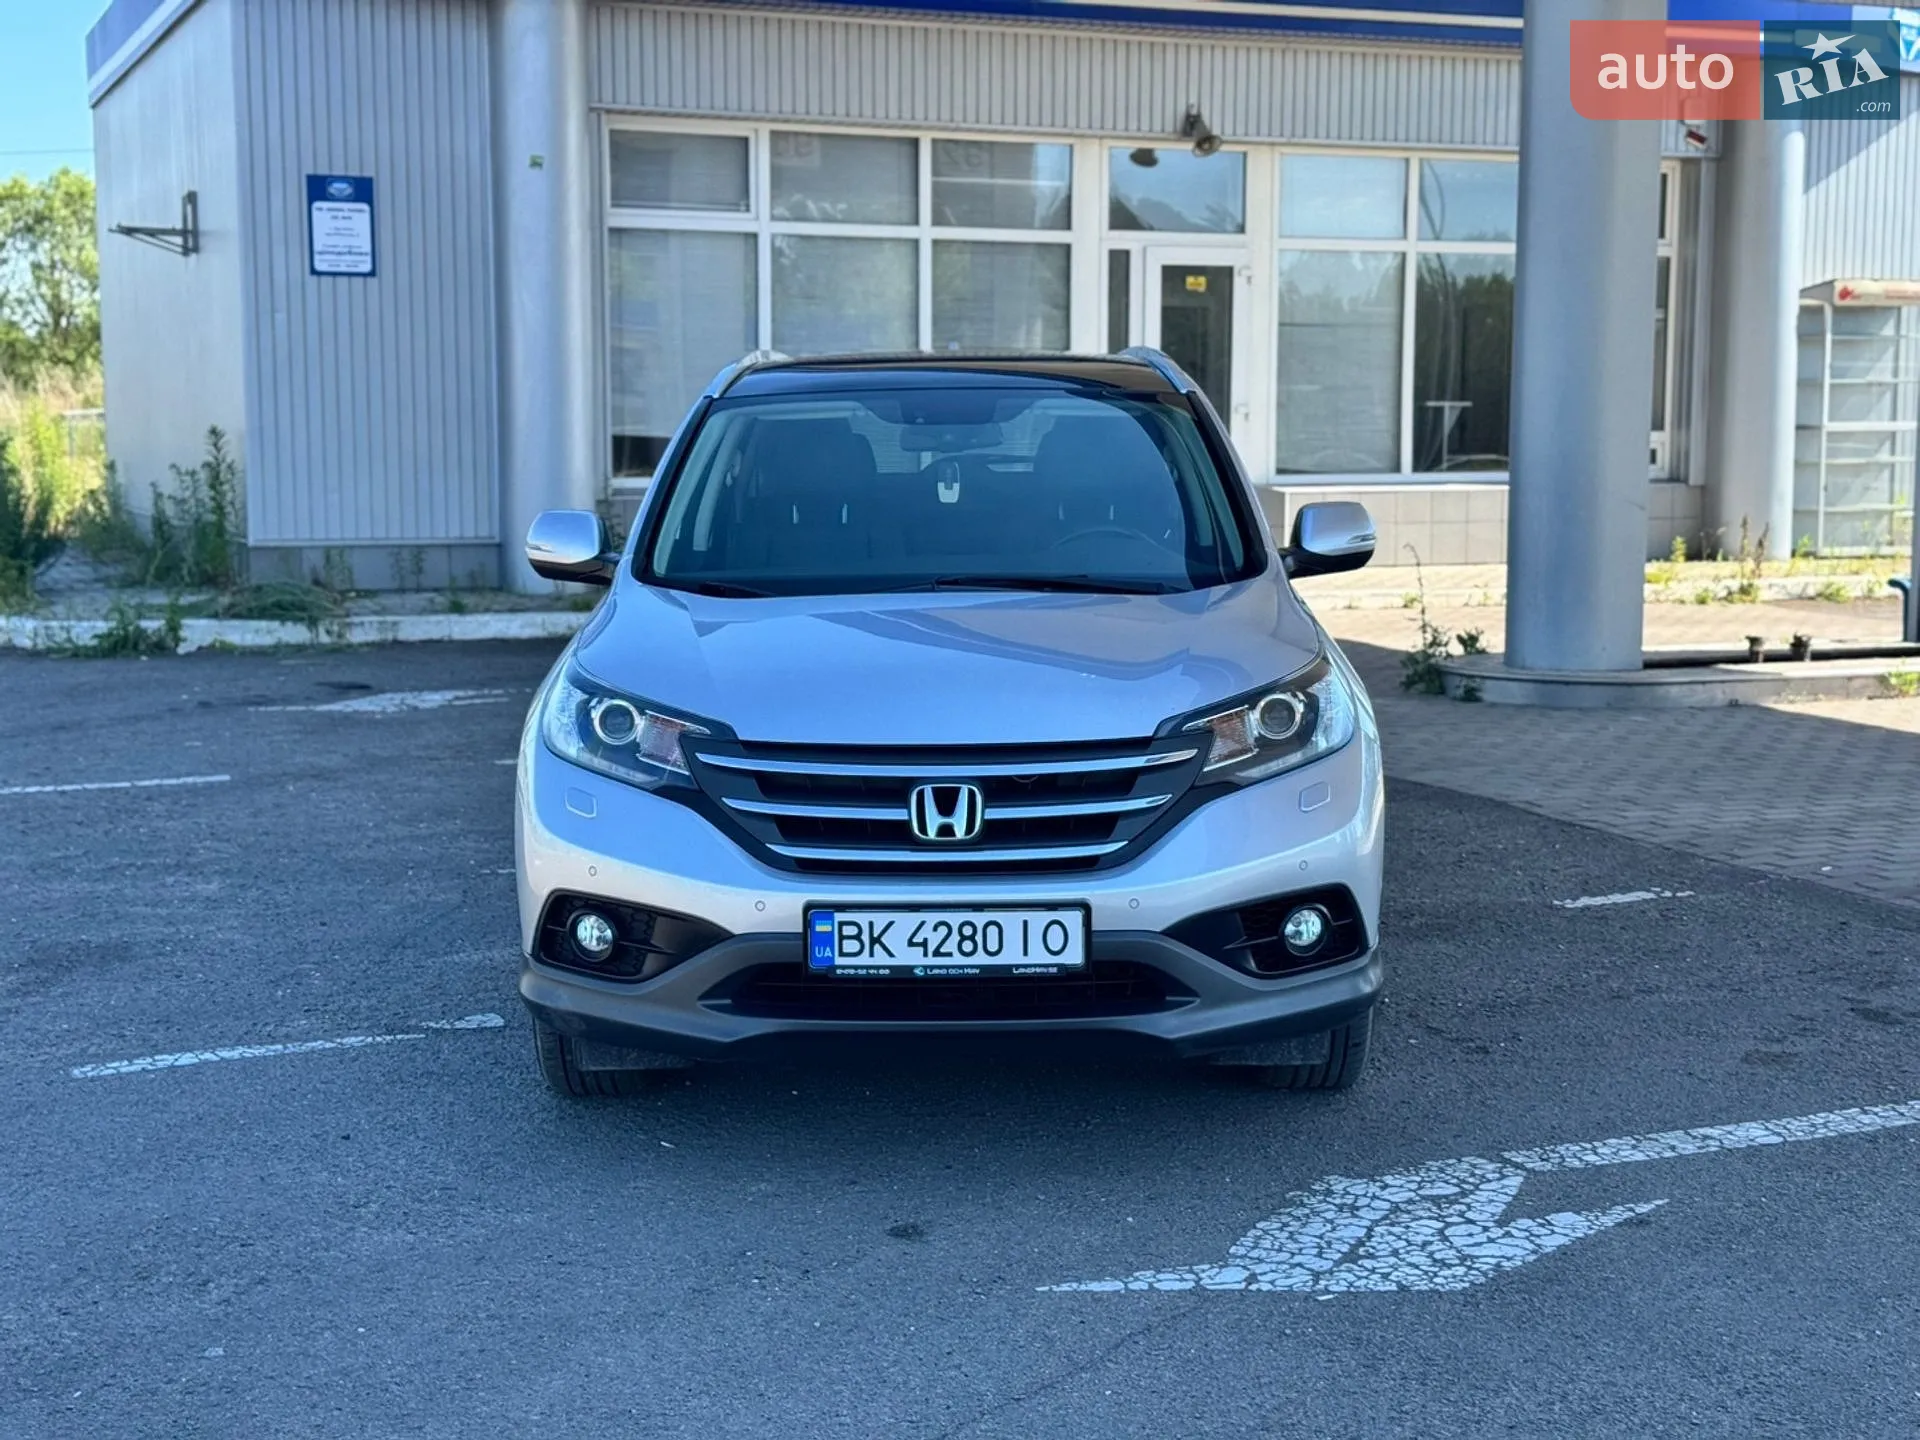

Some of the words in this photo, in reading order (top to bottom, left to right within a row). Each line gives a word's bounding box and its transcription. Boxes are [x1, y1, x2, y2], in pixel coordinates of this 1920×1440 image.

[837, 919, 896, 958] BK
[906, 919, 1004, 958] 4280
[815, 946, 833, 958] UA
